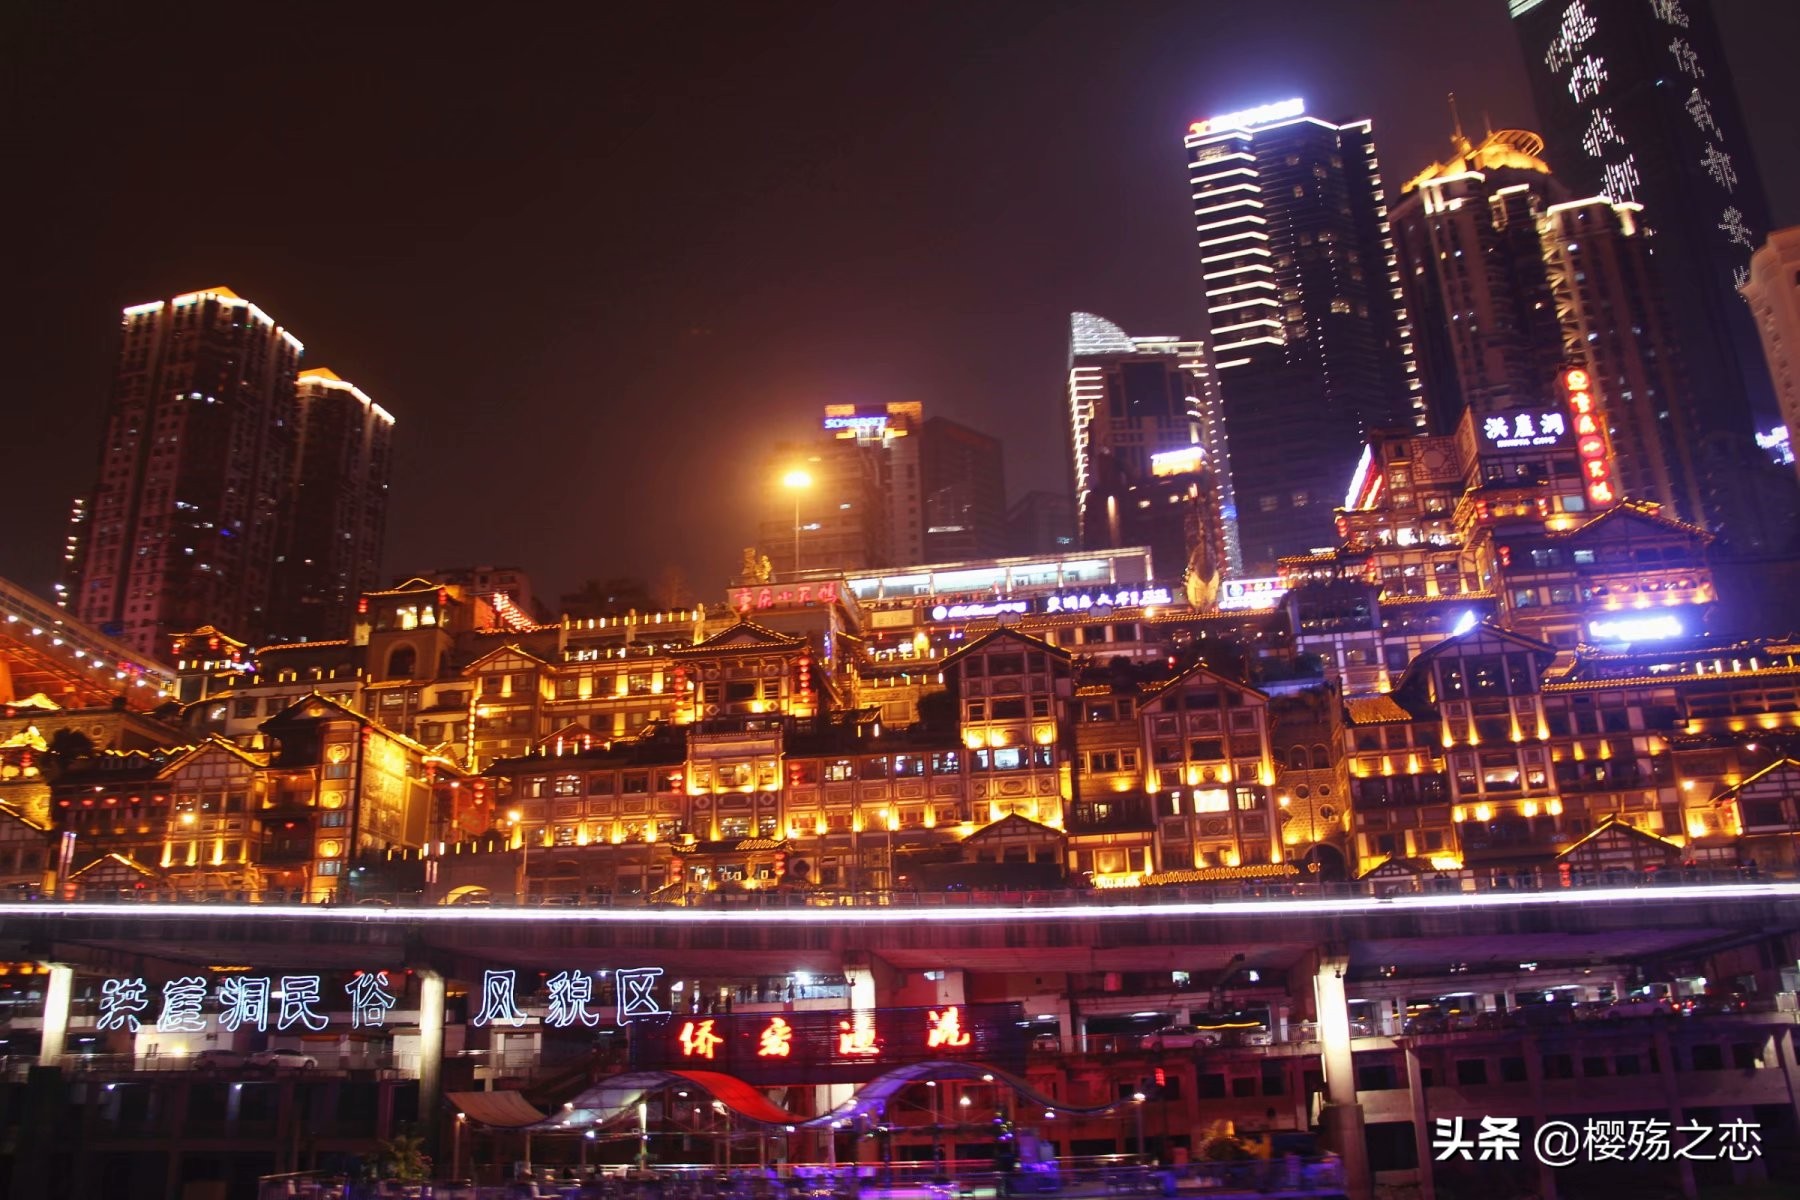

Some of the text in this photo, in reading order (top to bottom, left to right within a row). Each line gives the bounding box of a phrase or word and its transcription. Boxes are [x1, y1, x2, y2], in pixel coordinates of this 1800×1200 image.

[1483, 413, 1565, 440] 洪崖洞
[734, 582, 838, 611] 重庆小天鹅
[96, 967, 671, 1032] 洪崖洞民俗风貌区
